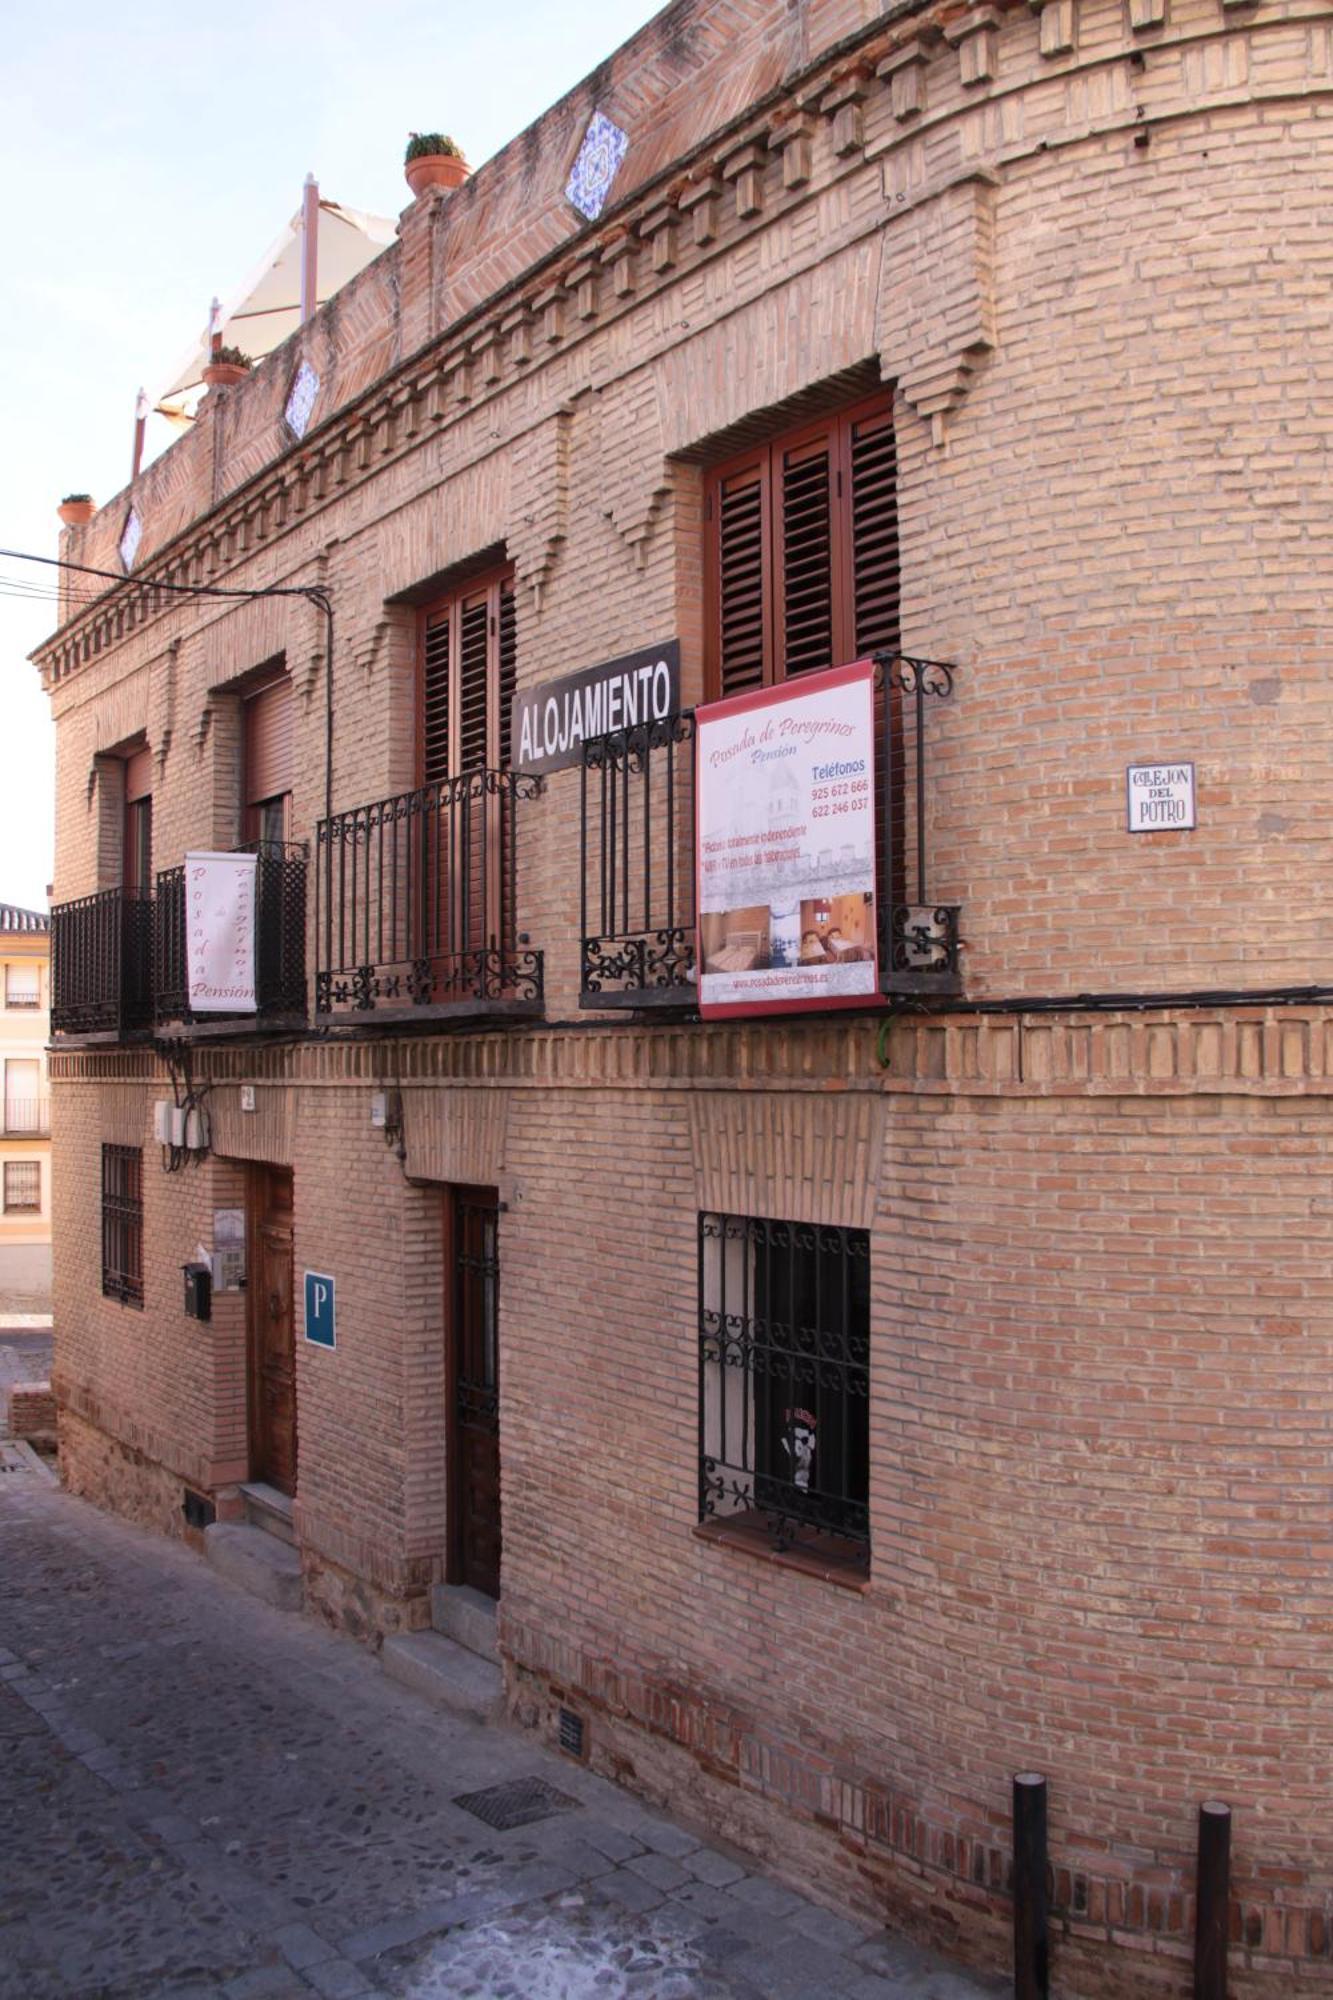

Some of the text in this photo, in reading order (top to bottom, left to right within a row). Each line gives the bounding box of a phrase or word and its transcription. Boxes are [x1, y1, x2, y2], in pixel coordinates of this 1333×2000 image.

[519, 661, 670, 764] ALOJAMIENTO
[710, 717, 856, 768] Posada de Peregrinos
[812, 759, 865, 780] Teléfonos
[812, 787, 829, 800] 925
[1149, 787, 1173, 798] DEL
[812, 804, 829, 818] 622
[1140, 800, 1185, 823] POTRO
[192, 982, 255, 998] Pensión
[314, 1283, 327, 1318] P
